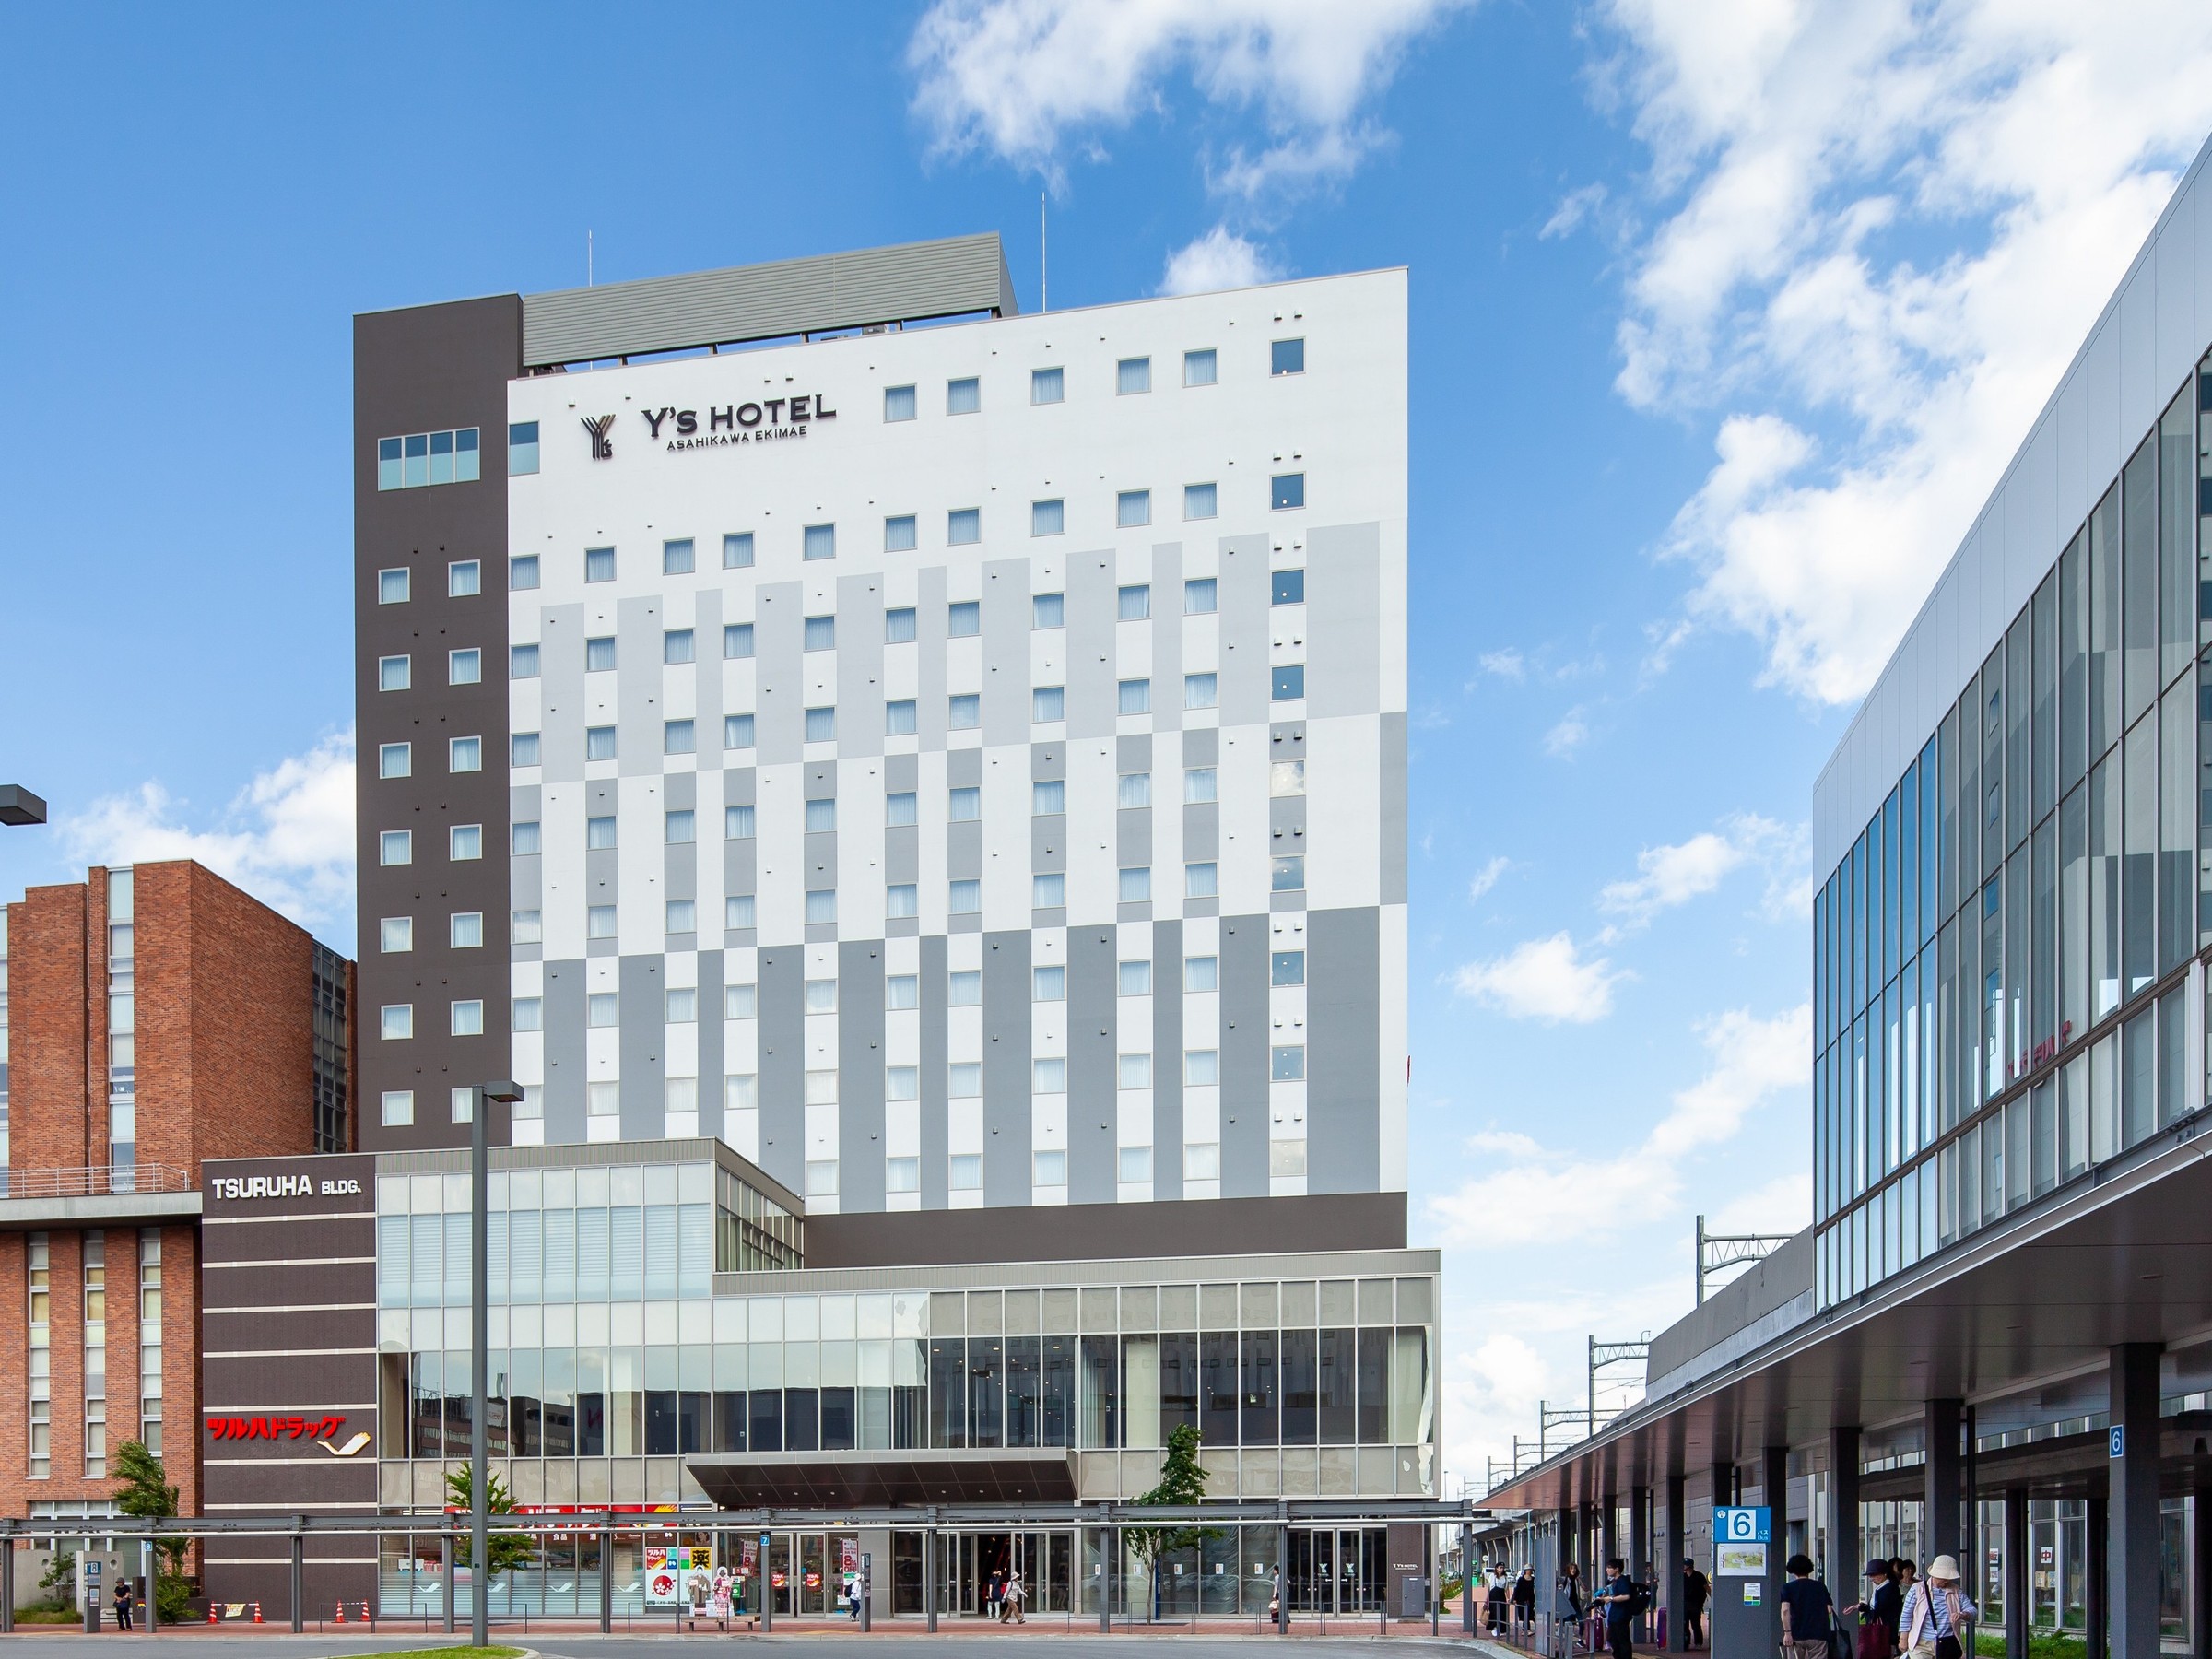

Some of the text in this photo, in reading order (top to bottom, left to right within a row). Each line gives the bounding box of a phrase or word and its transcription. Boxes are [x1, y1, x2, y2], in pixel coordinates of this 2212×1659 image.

[710, 394, 837, 430] HOTEL
[666, 425, 807, 451] ASAHIKAWA EKIMAE
[212, 1174, 362, 1199] TSURUHA BLDG.
[207, 1416, 347, 1440] ツルハドラッグ
[2112, 1430, 2121, 1453] 6
[1733, 1512, 1751, 1537] 6
[91, 1563, 98, 1572] 8
